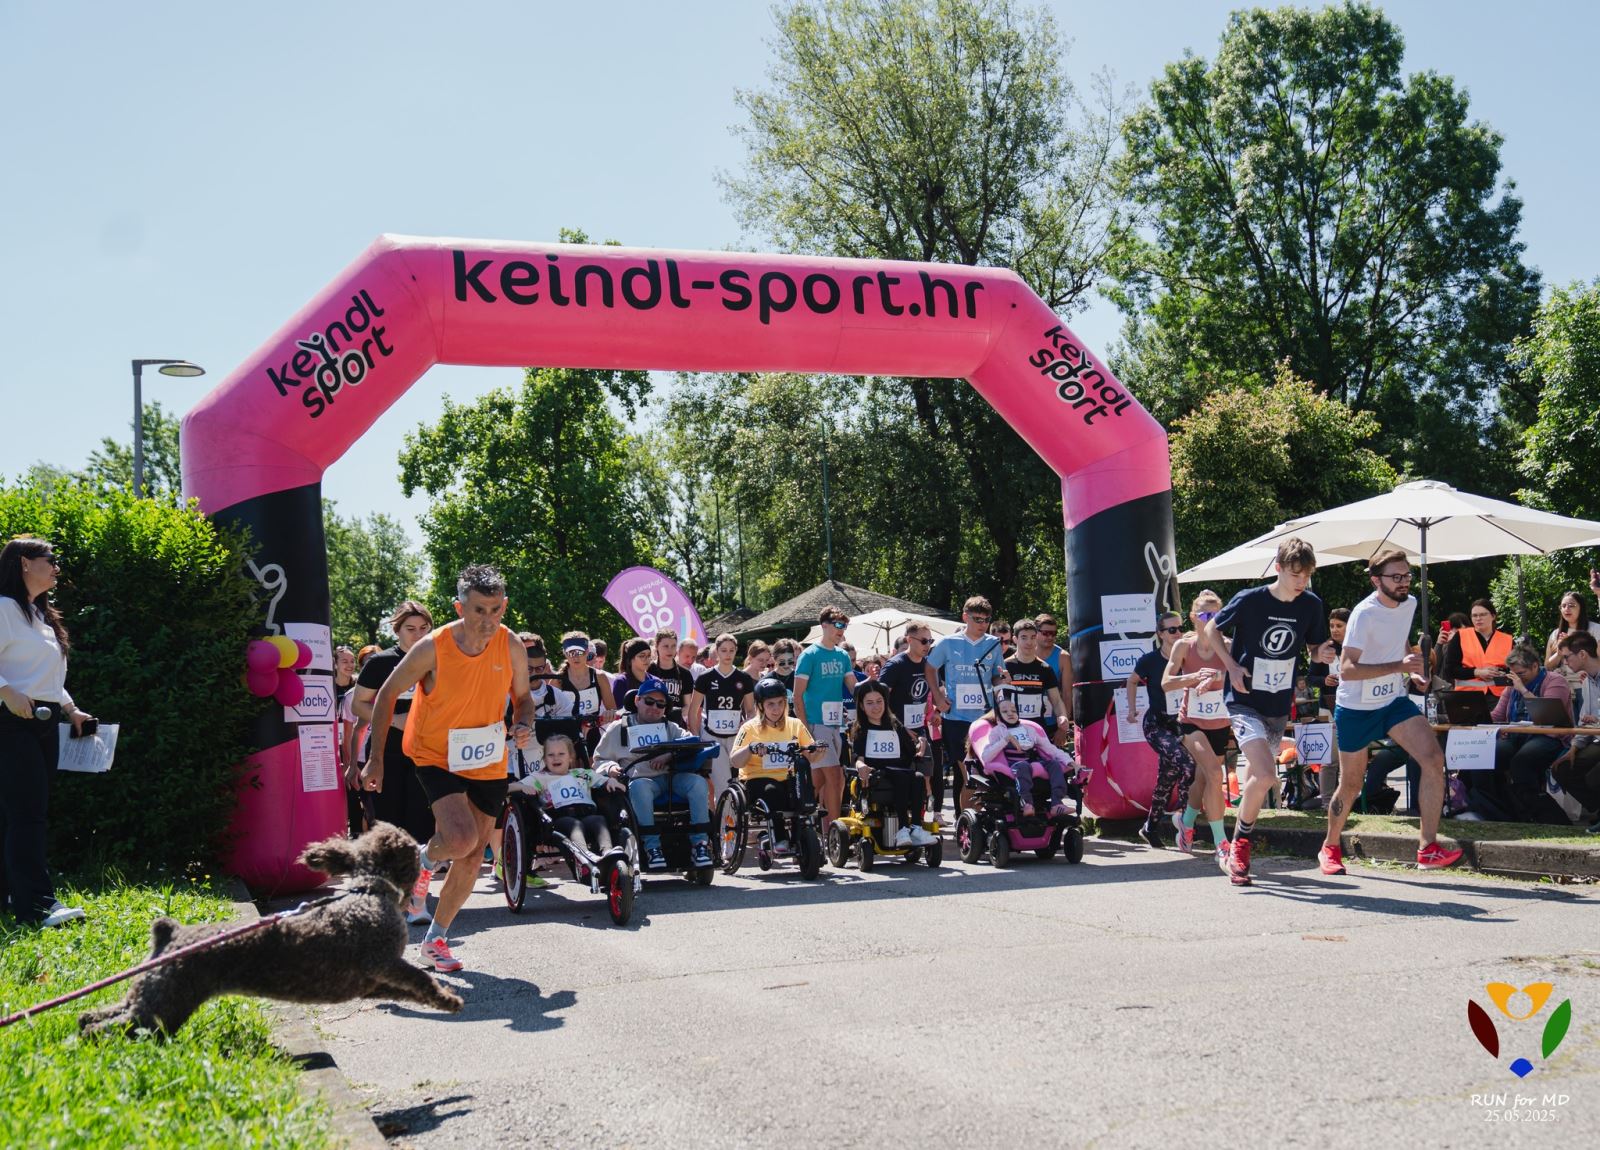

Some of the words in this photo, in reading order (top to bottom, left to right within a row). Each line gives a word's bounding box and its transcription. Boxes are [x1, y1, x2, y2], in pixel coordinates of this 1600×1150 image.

[453, 250, 985, 325] keindl-sport.hr
[302, 326, 394, 418] sport
[1029, 347, 1107, 425] sport
[1112, 653, 1138, 667] Roch
[821, 659, 843, 675] BUŠ?
[1264, 672, 1287, 686] 157
[1372, 682, 1394, 697] 081
[579, 700, 592, 710] 93
[717, 696, 734, 709] 23
[963, 694, 982, 703] 098
[1197, 702, 1220, 714] 187
[715, 720, 734, 729] 154
[638, 734, 661, 747] 004
[1302, 739, 1324, 752] Roche
[461, 742, 495, 761] 069
[873, 742, 894, 753] 188
